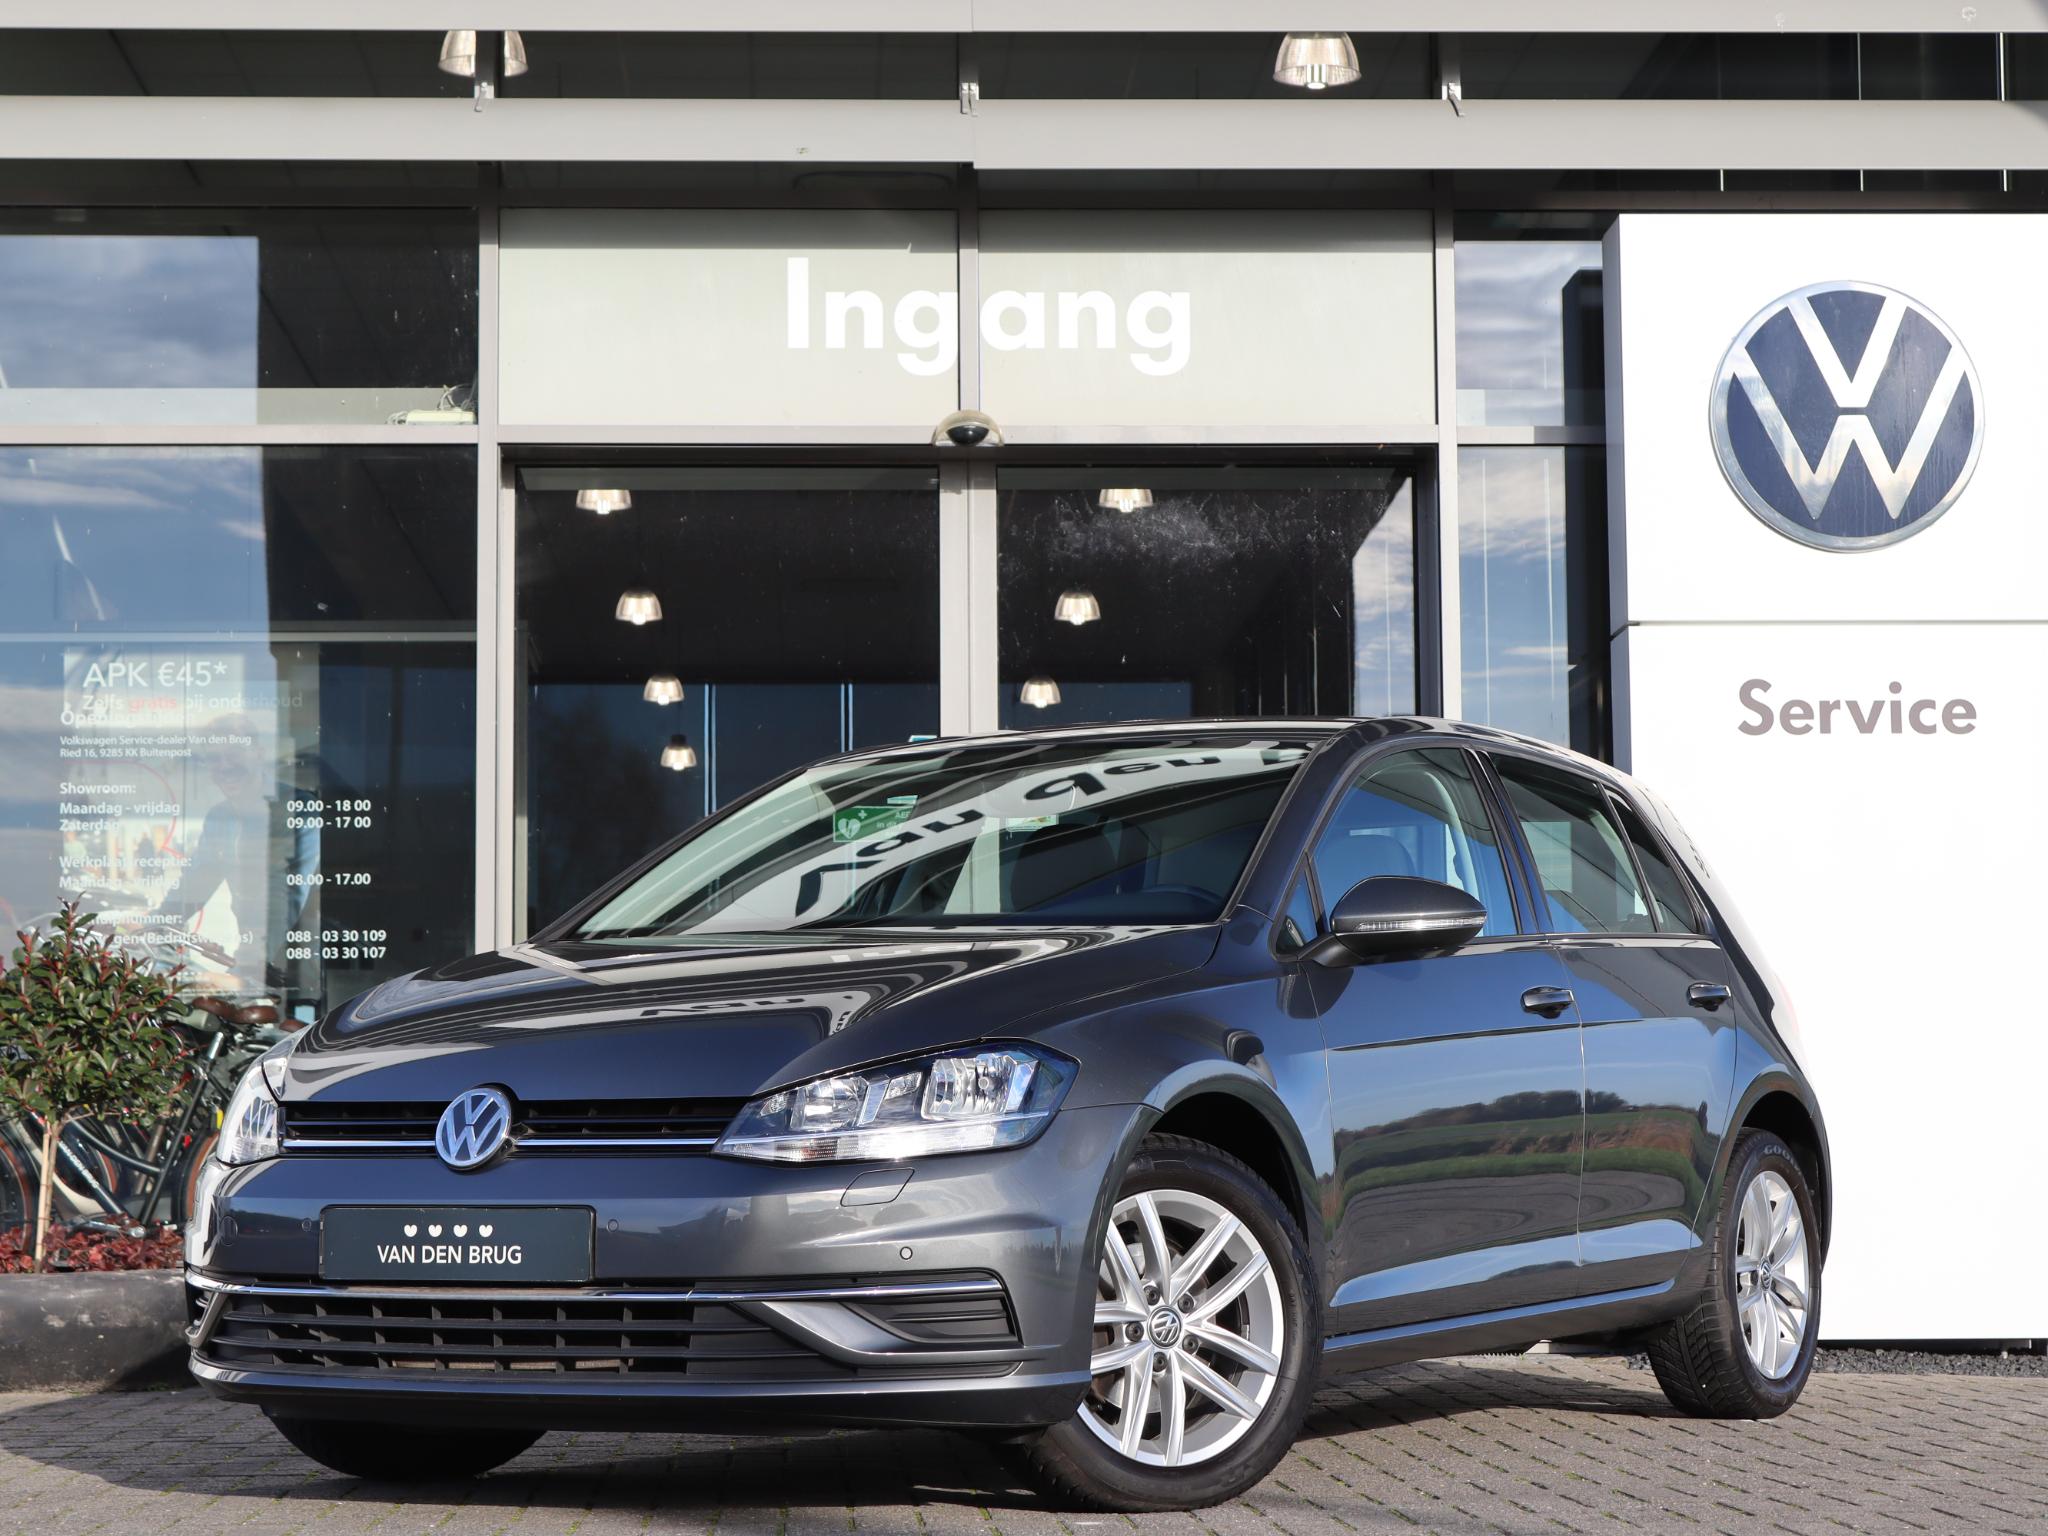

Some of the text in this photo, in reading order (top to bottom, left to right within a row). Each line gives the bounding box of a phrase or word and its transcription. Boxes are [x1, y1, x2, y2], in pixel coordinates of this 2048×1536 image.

[787, 257, 1191, 376] Ingang
[1723, 286, 1975, 528] VW
[83, 662, 148, 687] APK
[128, 695, 177, 713] gratis
[186, 694, 203, 713] bij
[1737, 679, 1977, 736] Service
[60, 735, 252, 748] Volkswagen Service-dealer Van den Brug
[60, 748, 81, 758] Ried
[84, 748, 97, 759] 16,
[100, 747, 123, 758] 9285
[140, 747, 192, 759] Buitenpost
[59, 782, 136, 794] Showroom:
[60, 802, 122, 816] Maandag
[133, 801, 181, 816] vrijdag
[287, 800, 324, 812] 09.00
[335, 800, 351, 811] 18
[354, 800, 371, 812] 00
[60, 819, 121, 833] Zaterdag
[287, 817, 324, 829] 09.00
[335, 817, 351, 828] 17
[354, 816, 371, 828] 00
[287, 874, 324, 885] 08.00
[335, 873, 371, 885] 17.00
[286, 931, 312, 942] 088
[322, 931, 338, 942] 03
[342, 930, 358, 942] 30
[362, 930, 387, 941] 109
[286, 948, 312, 959] 088
[322, 947, 338, 959] 03
[342, 947, 358, 958] 30
[362, 947, 387, 958] 107
[377, 1245, 522, 1265] VAN DEN BRUG
